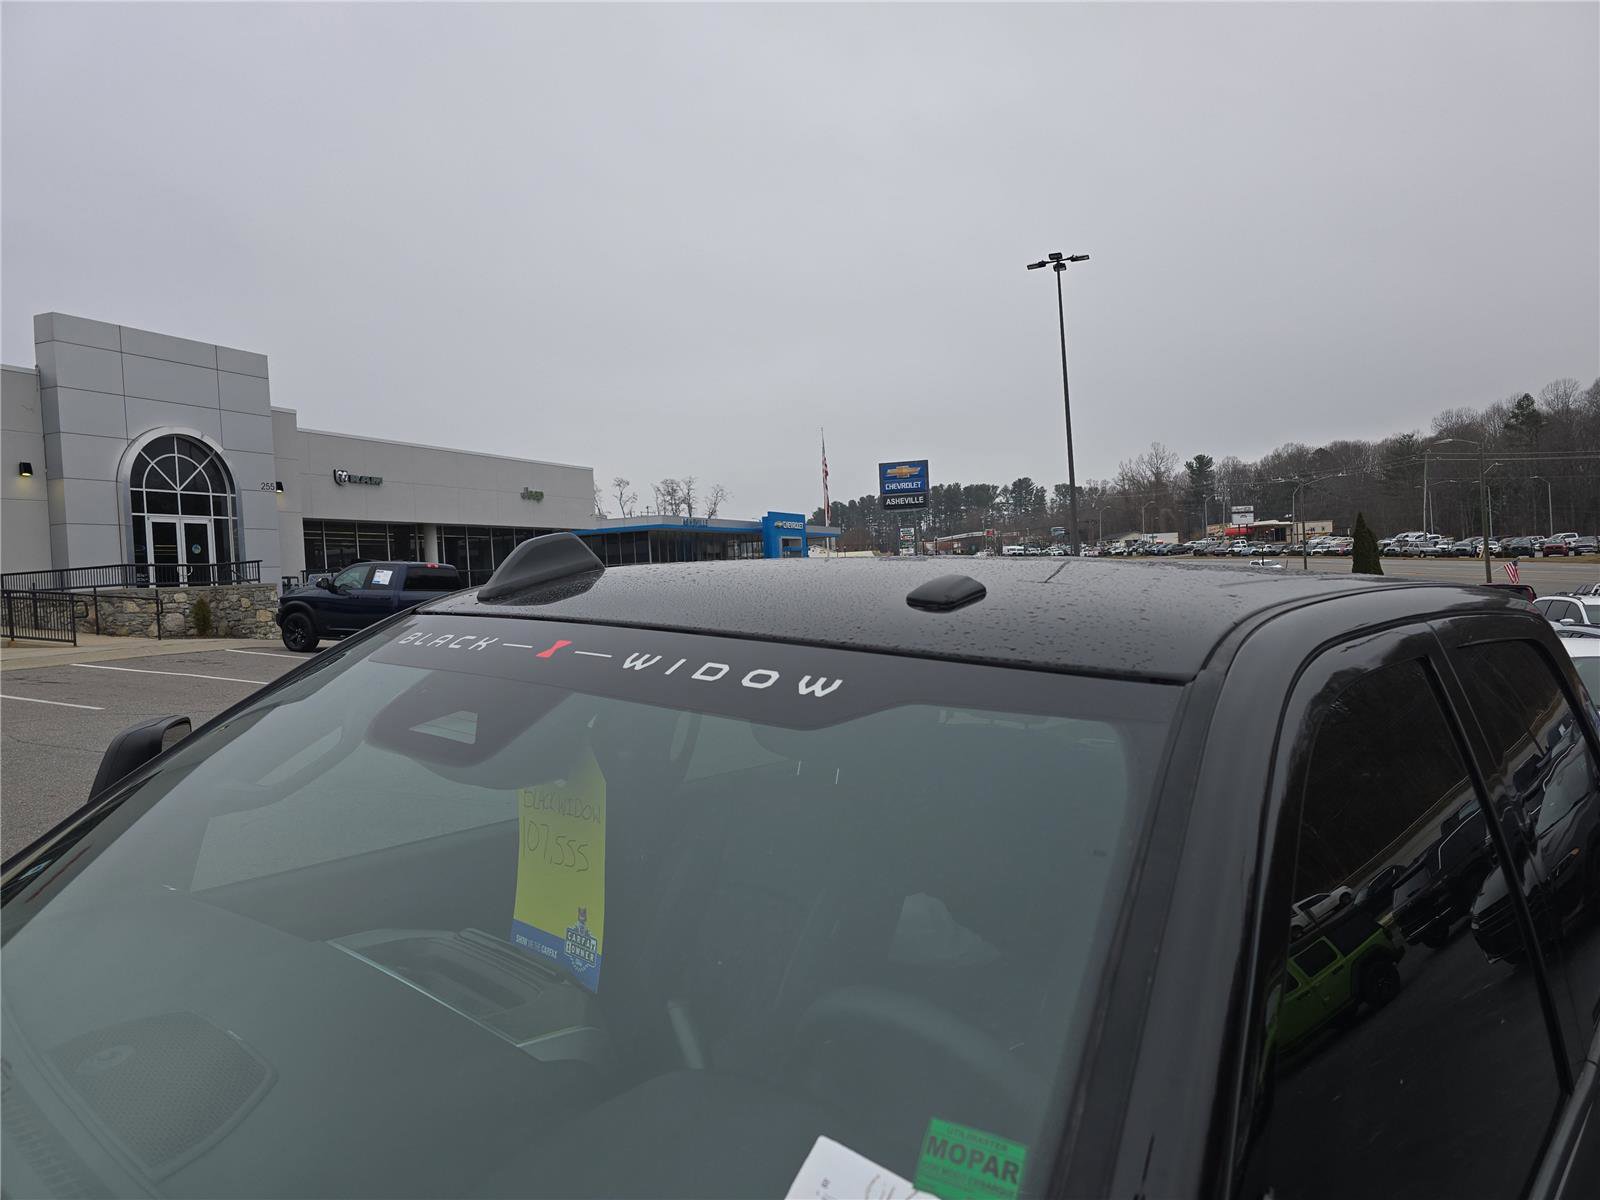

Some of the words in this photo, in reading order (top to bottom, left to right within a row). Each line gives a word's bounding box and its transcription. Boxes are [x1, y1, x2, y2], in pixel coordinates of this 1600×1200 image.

[260, 482, 275, 491] 255
[885, 482, 921, 491] CHEVROLET
[885, 496, 924, 505] ASHEVILLE
[398, 632, 499, 651] BLACK
[622, 652, 843, 698] WIDOW
[926, 1135, 1020, 1185] MOPAR
